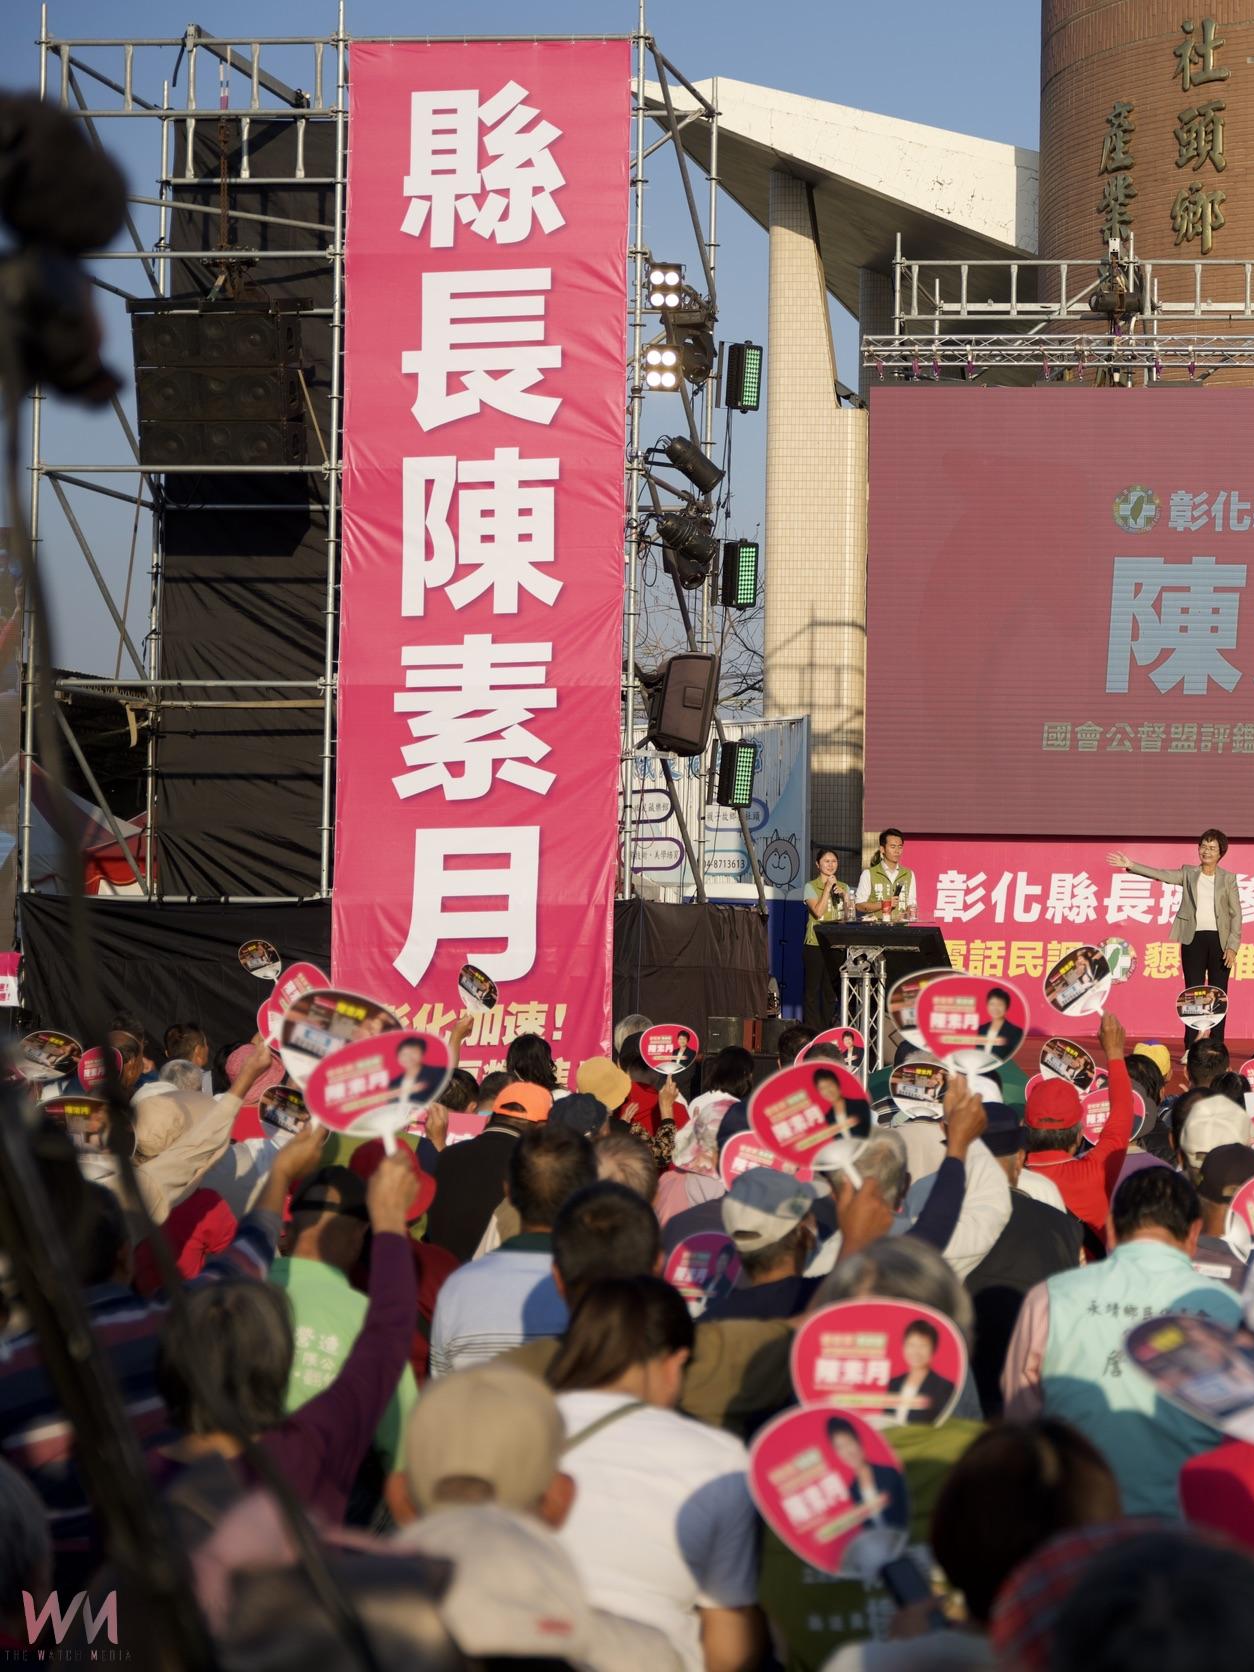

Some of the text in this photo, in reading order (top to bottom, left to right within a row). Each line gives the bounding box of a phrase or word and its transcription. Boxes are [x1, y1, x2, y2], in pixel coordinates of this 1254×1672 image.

[1171, 17, 1231, 255] 社頭鄉
[391, 79, 567, 987] 縣長陳素月
[814, 1358, 892, 1386] 陳素月
